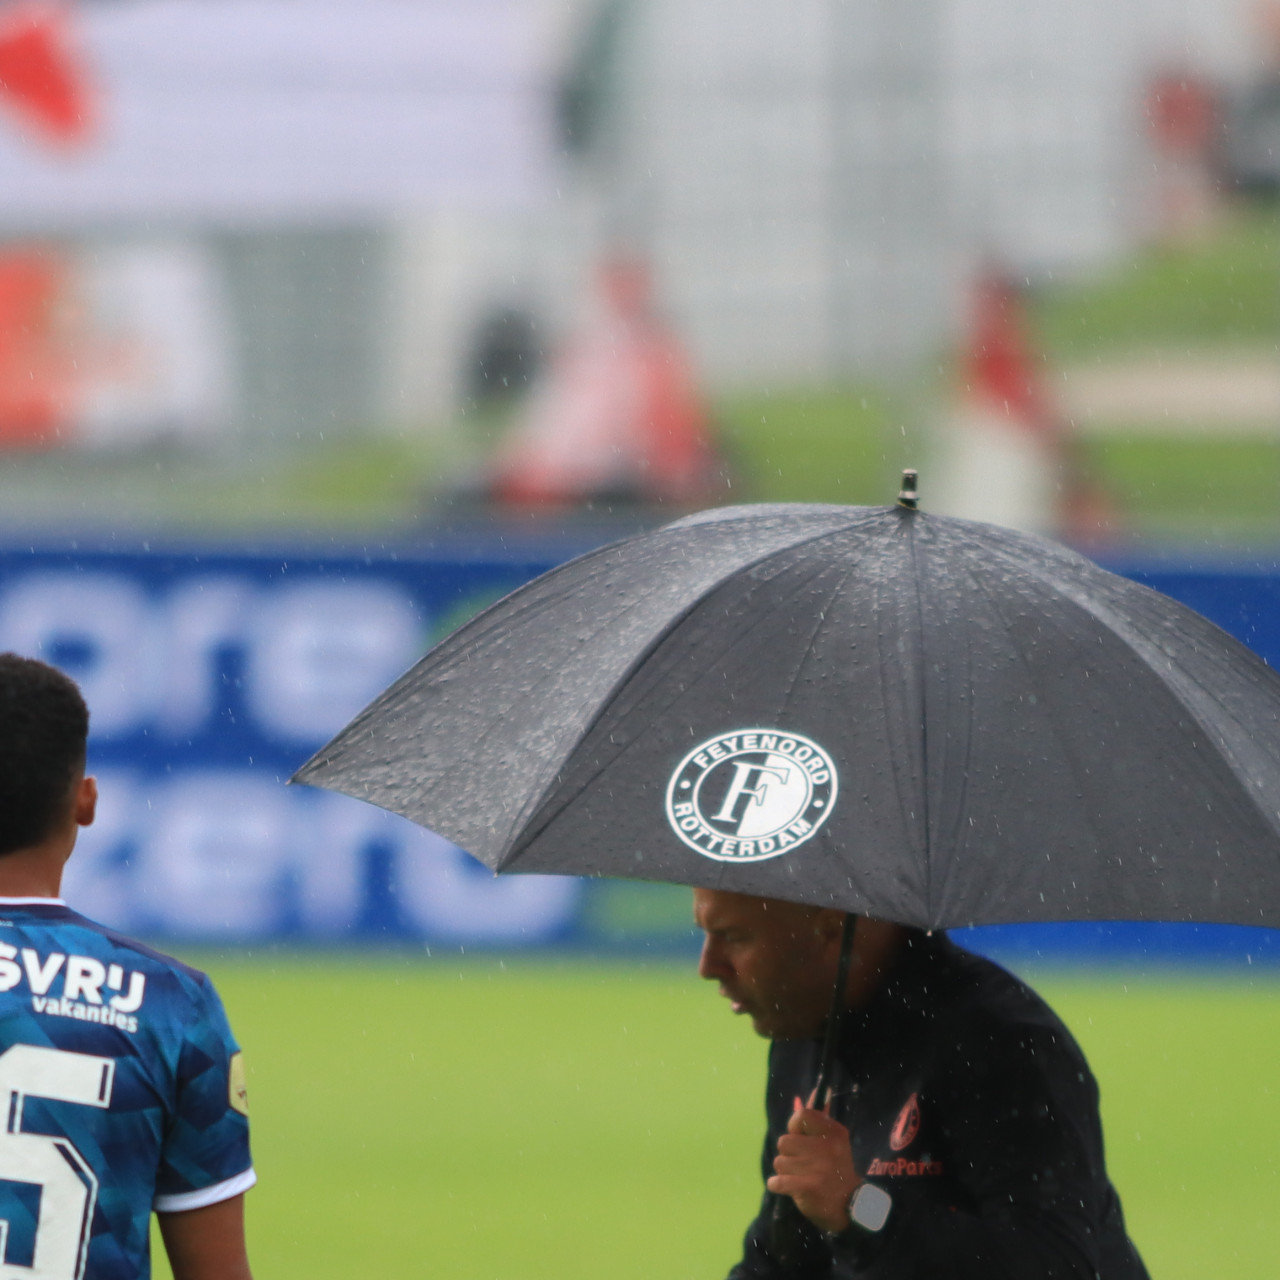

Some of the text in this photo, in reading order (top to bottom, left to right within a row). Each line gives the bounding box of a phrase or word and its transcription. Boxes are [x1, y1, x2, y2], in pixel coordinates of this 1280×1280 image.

[692, 734, 830, 786] FEYENOORD
[674, 800, 813, 857] ROTTERDAM
[32, 994, 138, 1034] vakanties
